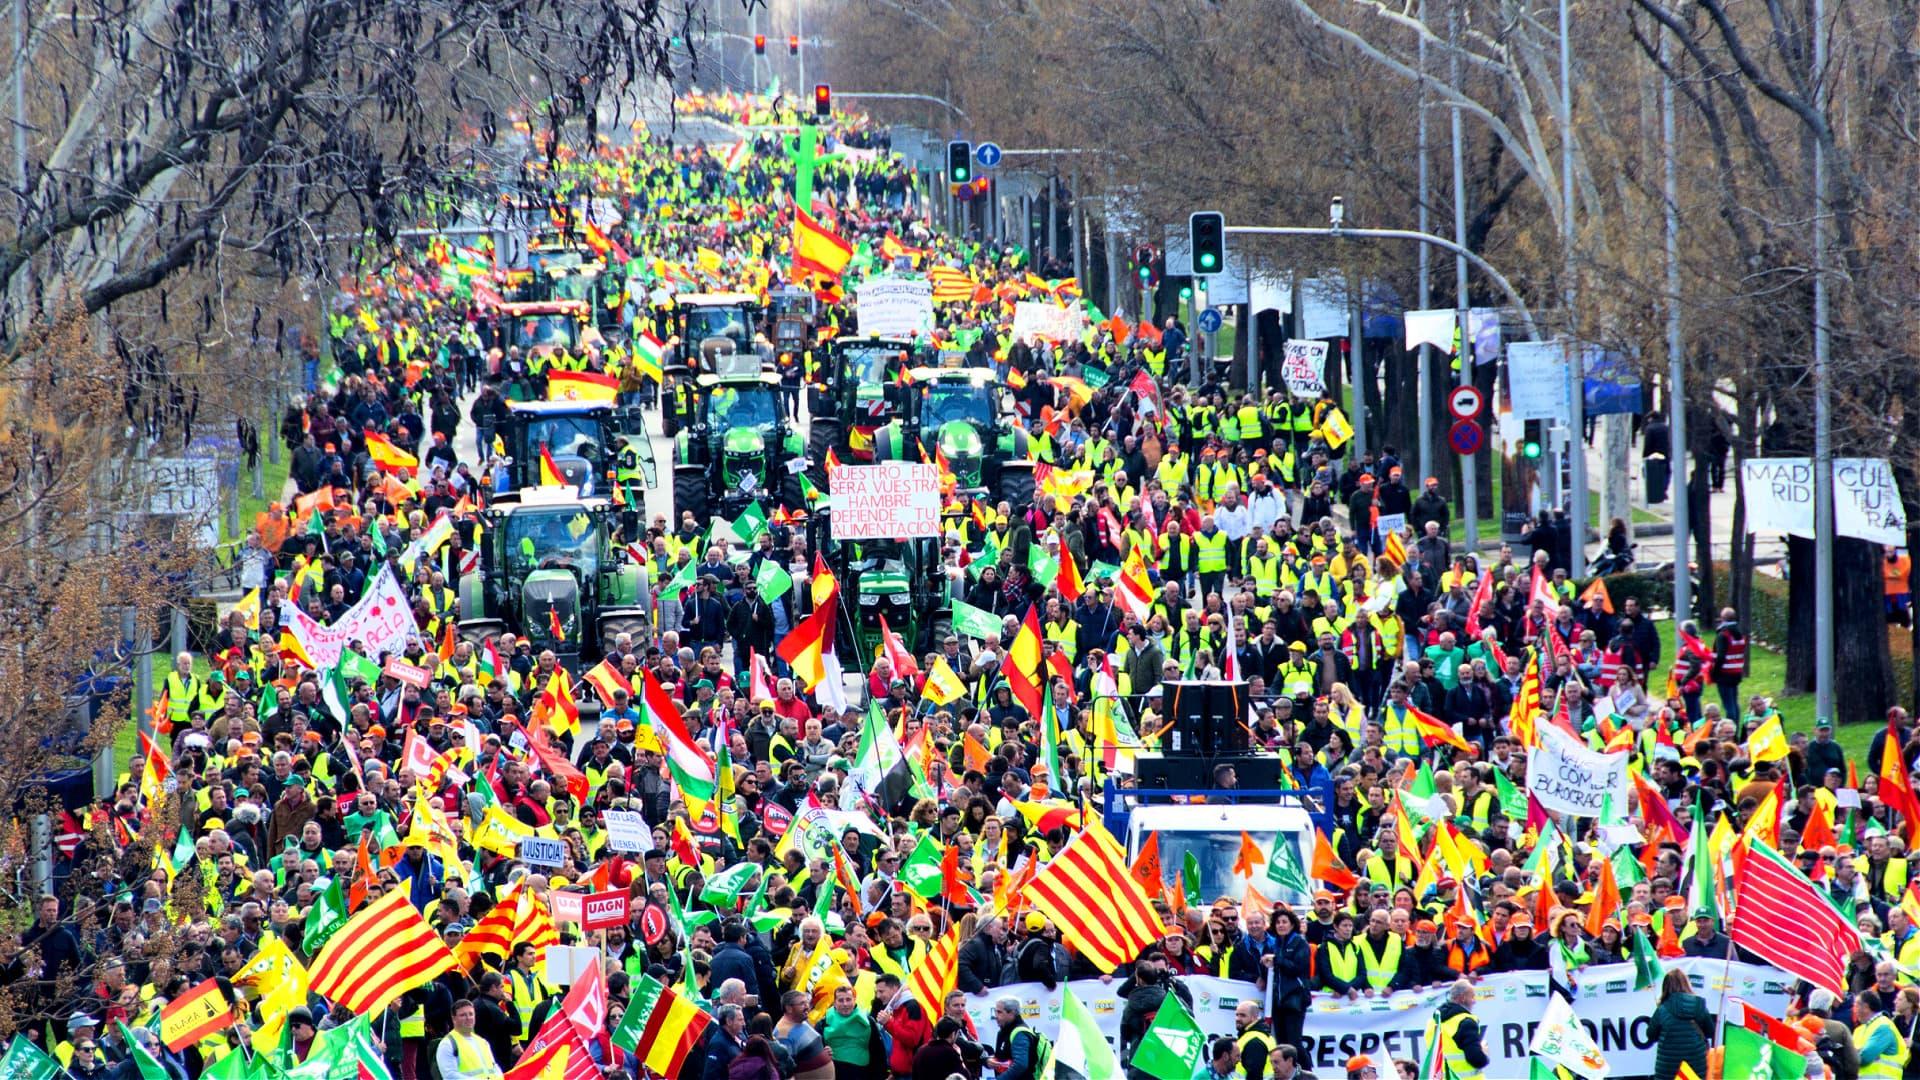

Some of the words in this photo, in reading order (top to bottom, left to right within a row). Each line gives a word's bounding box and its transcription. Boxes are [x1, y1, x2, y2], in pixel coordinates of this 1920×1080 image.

[829, 466, 900, 480] NUESTRO
[911, 465, 938, 479] FIN
[1747, 465, 1810, 484] MAD
[1838, 466, 1889, 488] CUL
[830, 481, 867, 494] SERA
[872, 480, 939, 493] VUESTRA
[1771, 482, 1810, 503] RID
[848, 494, 912, 508] HAMBRE
[1849, 488, 1881, 510] TU
[831, 509, 896, 523] DEFIENDE
[914, 507, 935, 520] TU
[832, 521, 940, 537] ALIMENTACION
[612, 840, 639, 850] VIENEN
[588, 899, 624, 914] UAGN
